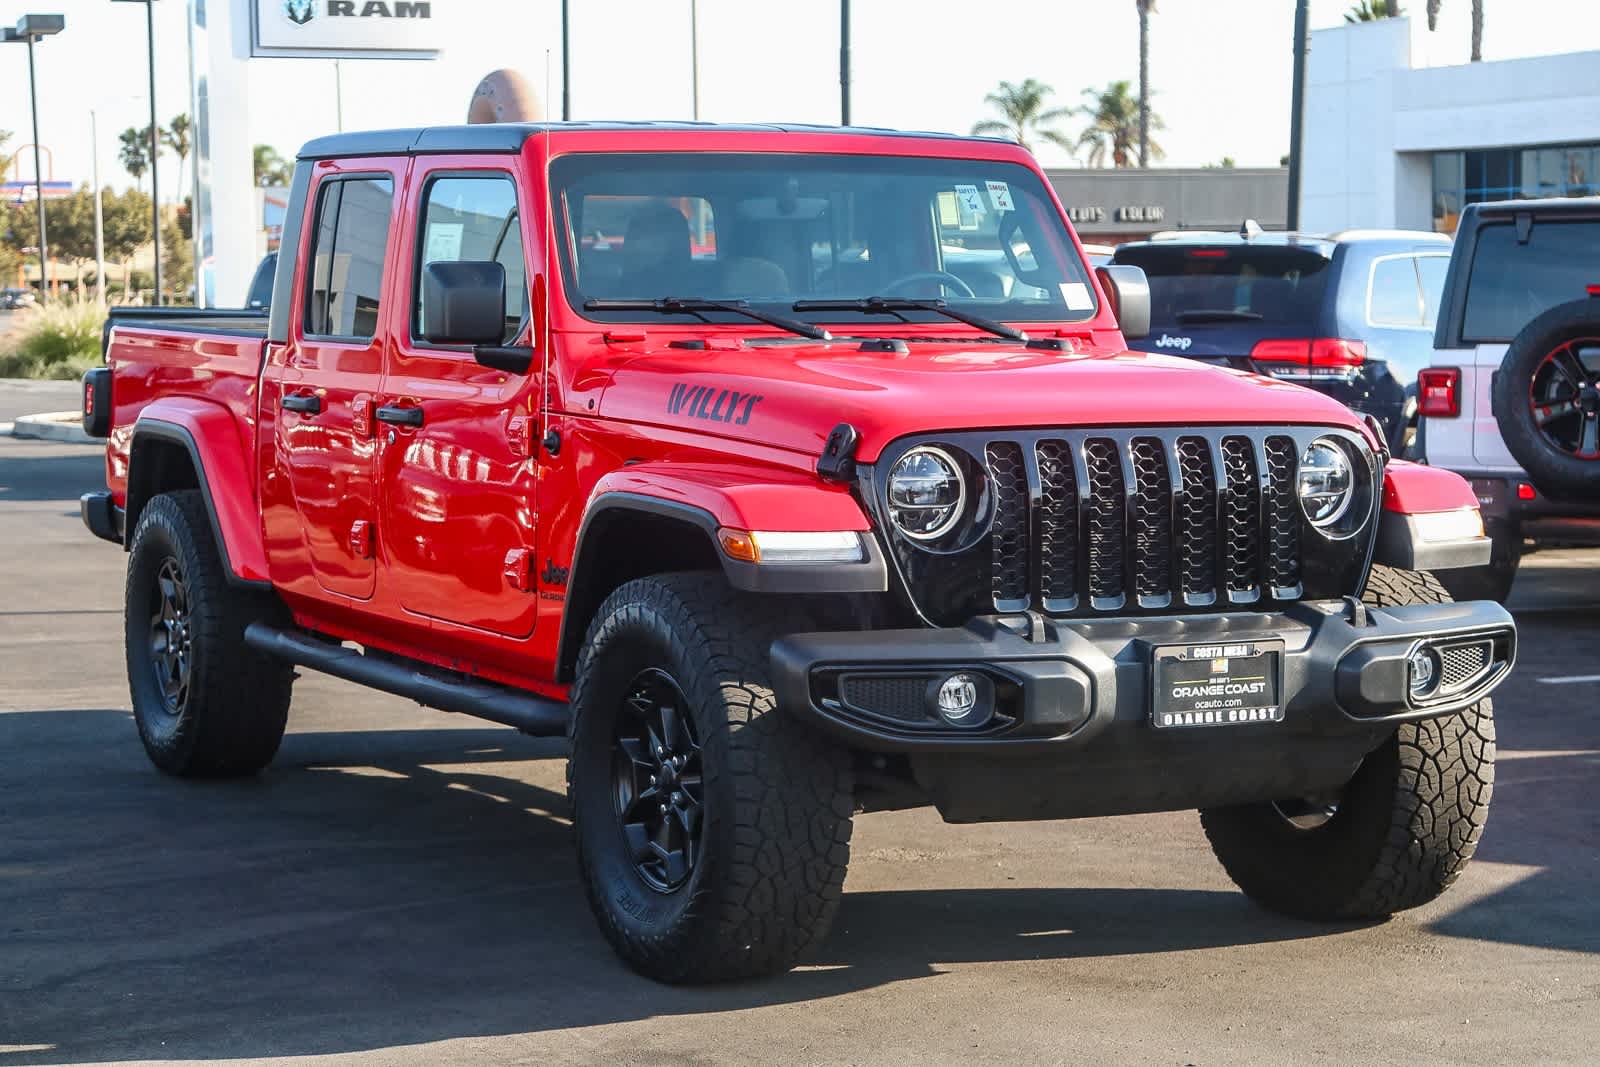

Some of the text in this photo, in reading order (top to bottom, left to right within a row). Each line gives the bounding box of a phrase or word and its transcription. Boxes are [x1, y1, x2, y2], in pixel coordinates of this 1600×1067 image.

[327, 0, 431, 19] RAM
[1155, 334, 1192, 350] Jeep
[667, 382, 764, 425] WILLYS
[1193, 645, 1248, 658] COSTA MESA
[1195, 699, 1242, 709] ocauto.com
[1164, 708, 1276, 725] ORANGE COAST
